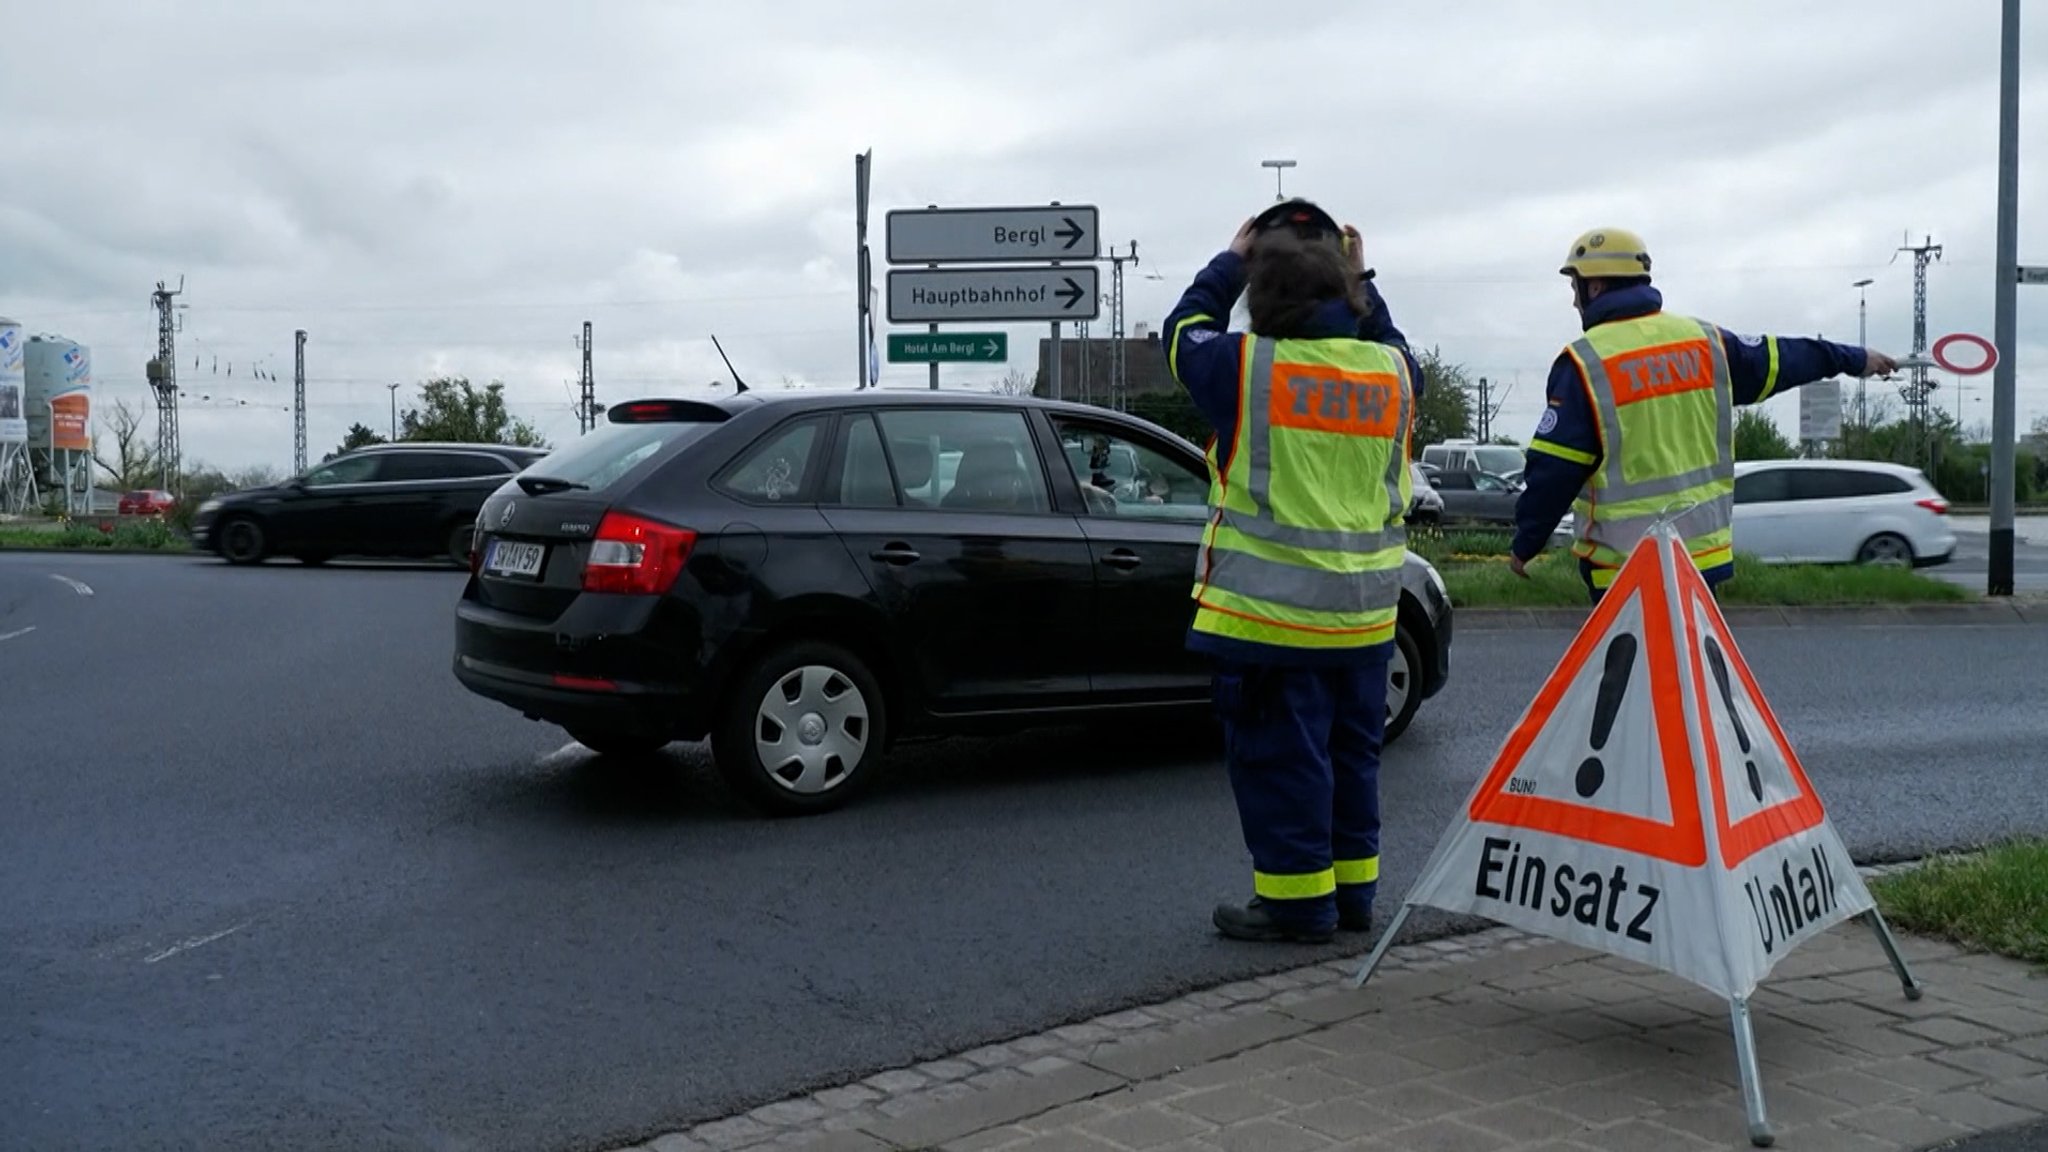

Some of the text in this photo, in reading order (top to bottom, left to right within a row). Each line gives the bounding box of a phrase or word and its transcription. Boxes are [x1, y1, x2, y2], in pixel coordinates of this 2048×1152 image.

[994, 226, 1046, 246] Bergl
[912, 284, 1046, 307] Hauptbahnhof
[904, 342, 975, 356] Hotel Am Bergl
[1619, 348, 1700, 391] THW
[1288, 375, 1392, 424] THW
[1476, 837, 1660, 944] Einsatz
[1745, 844, 1838, 954] Unfall
